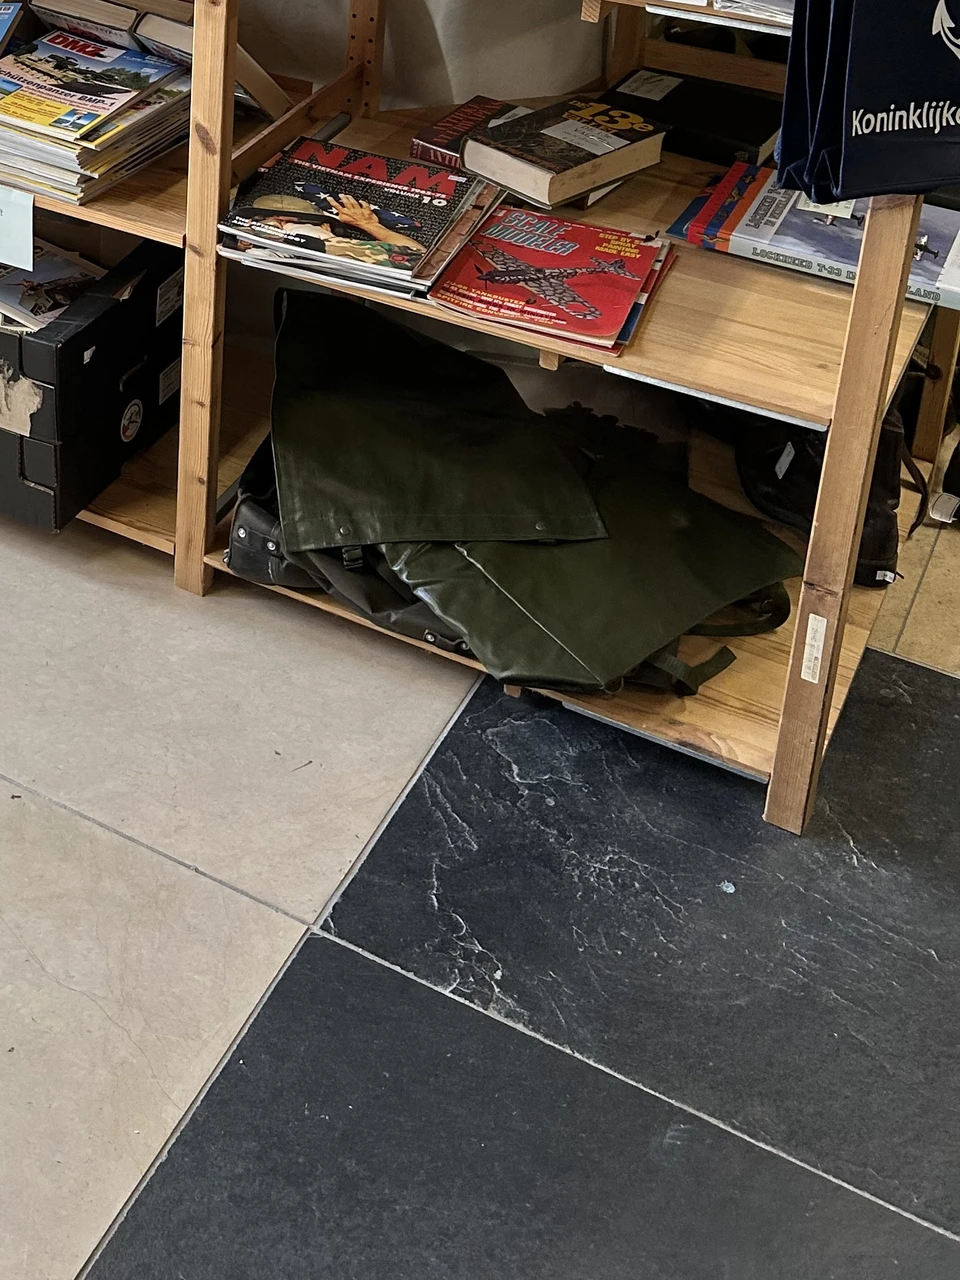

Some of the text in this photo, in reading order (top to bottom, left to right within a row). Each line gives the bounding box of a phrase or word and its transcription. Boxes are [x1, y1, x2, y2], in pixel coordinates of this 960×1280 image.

[46, 33, 106, 58] DMZ
[79, 93, 118, 108] BMP-1
[291, 140, 457, 198] NAM
[293, 158, 410, 191] THE VIETNAM EXPERIENCE
[423, 196, 448, 207] 10
[501, 211, 572, 239] SCALE
[480, 223, 580, 257] MODELER
[595, 246, 617, 256] MADE
[752, 246, 813, 269] LOCKHEED
